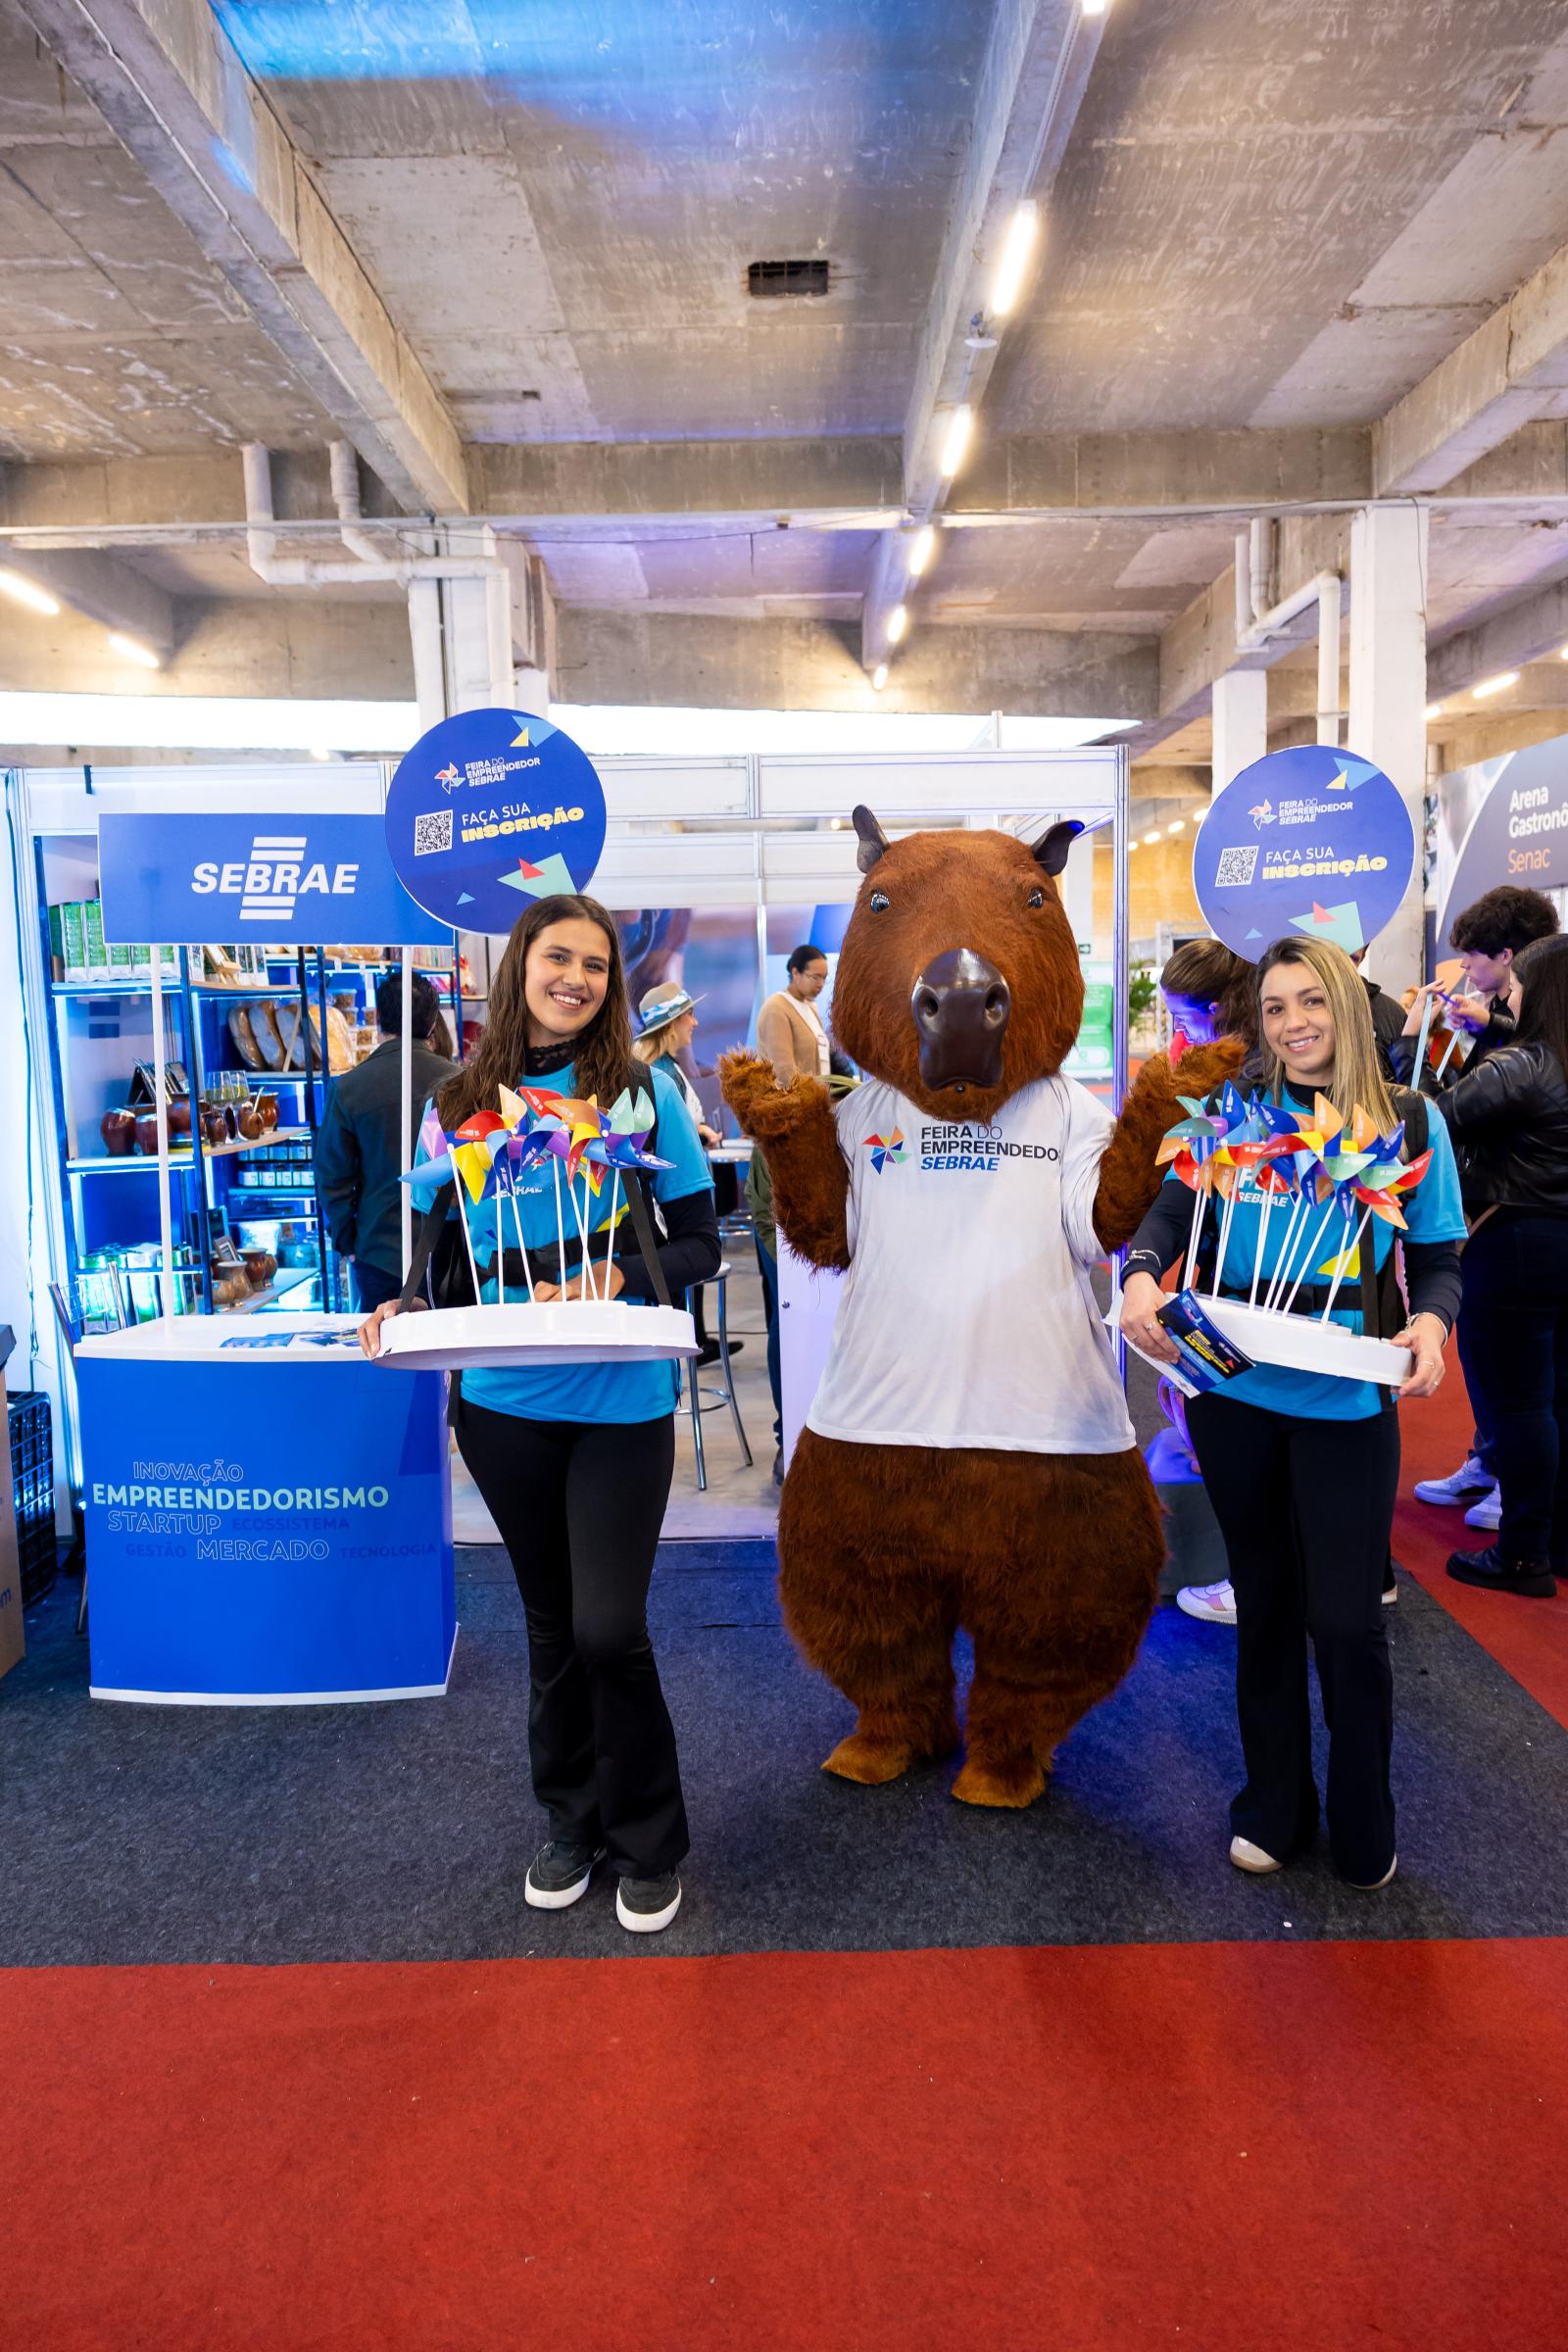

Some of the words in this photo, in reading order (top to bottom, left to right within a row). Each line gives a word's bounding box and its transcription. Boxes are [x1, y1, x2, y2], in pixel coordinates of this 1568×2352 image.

[465, 759, 491, 771] FEIRA
[491, 757, 505, 766] DO
[466, 758, 541, 779] EMPREENDEDOR
[468, 772, 506, 787] SEBRAE
[1279, 799, 1304, 809] FEIRA
[1304, 798, 1318, 808] DO
[1279, 802, 1353, 817] EMPREENDEDOR
[1509, 786, 1549, 812] Arena
[461, 807, 585, 843] INSCRIÇÃO
[462, 808, 499, 827] FAÇA
[502, 803, 531, 818] SUA
[1279, 813, 1317, 825] SEBRAE
[1265, 850, 1301, 864] FAÇA
[1305, 846, 1335, 859] SUA
[1508, 848, 1551, 874] Senac
[1262, 855, 1388, 879] INSCRIÇÃO
[191, 862, 360, 894] SEBRAE
[920, 1125, 973, 1140] FEIRA
[977, 1126, 1003, 1140] DO
[920, 1141, 1062, 1162] EMPREENDEDO
[920, 1156, 1001, 1171] SEBRAE
[132, 1459, 244, 1487] INOVAÇÃO
[92, 1483, 390, 1511] EMPREENDEDORISMO
[108, 1511, 221, 1535] STARTUP
[231, 1517, 351, 1532] ECOSSISTEMA
[124, 1542, 187, 1559] GESTÃO
[196, 1539, 330, 1561] MERCADO
[339, 1544, 437, 1559] TECNOLOGIA
